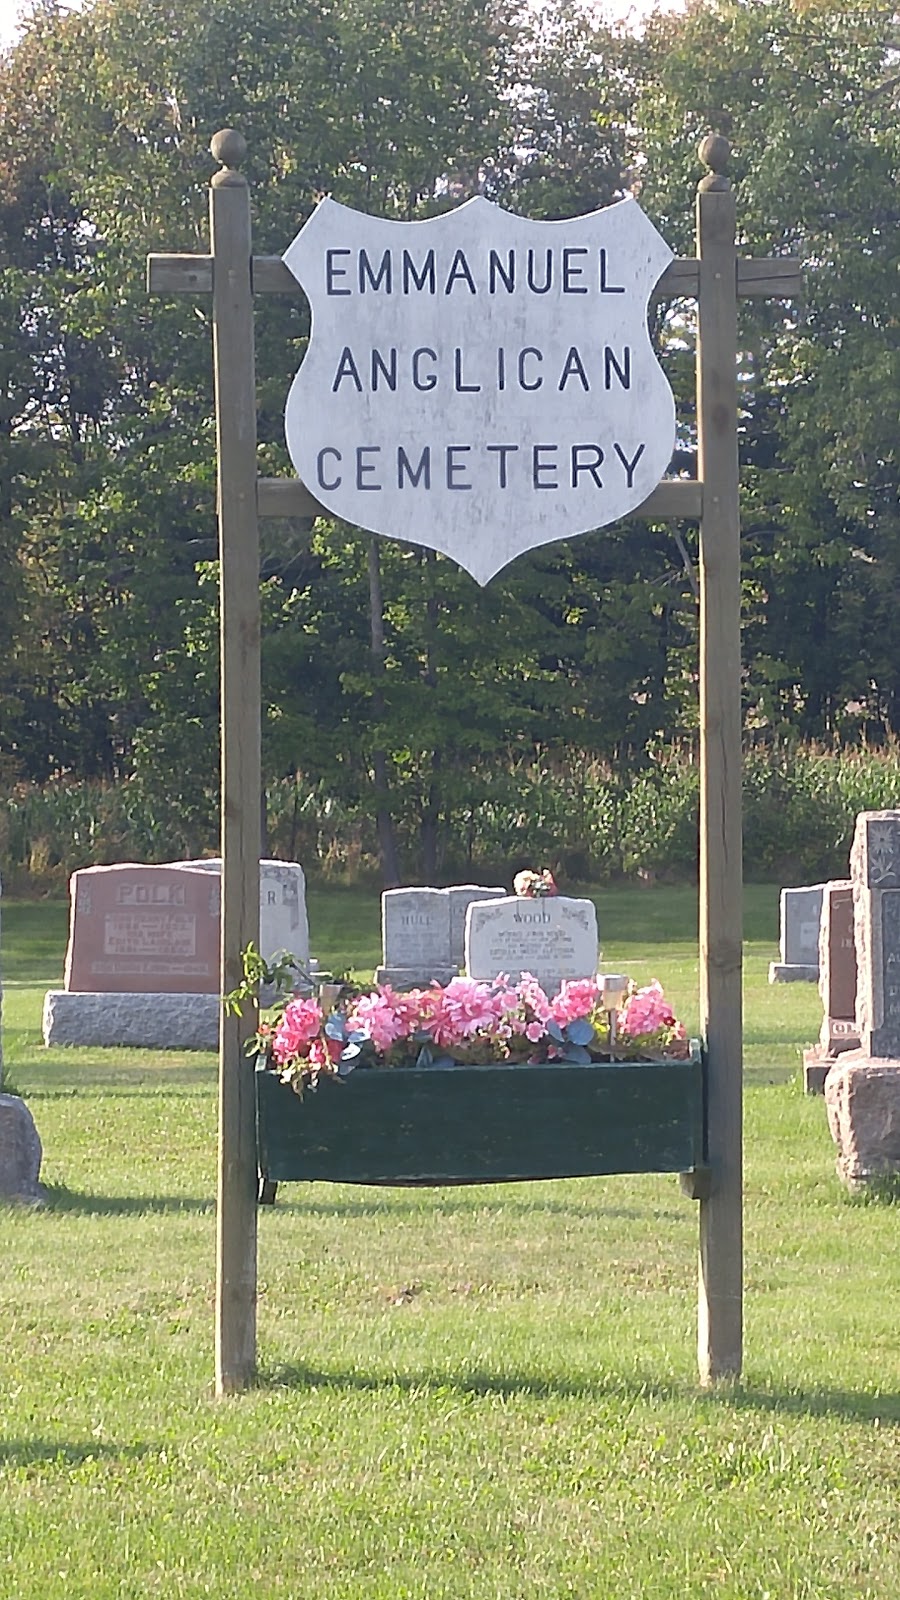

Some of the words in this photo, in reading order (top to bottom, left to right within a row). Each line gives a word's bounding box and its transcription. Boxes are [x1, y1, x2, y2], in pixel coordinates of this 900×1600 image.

[325, 248, 626, 295] EMMANUEL
[332, 346, 631, 392] ANGLICAN
[316, 443, 646, 491] CEMETERY
[118, 884, 185, 905] POLK
[513, 912, 551, 924] WOOD
